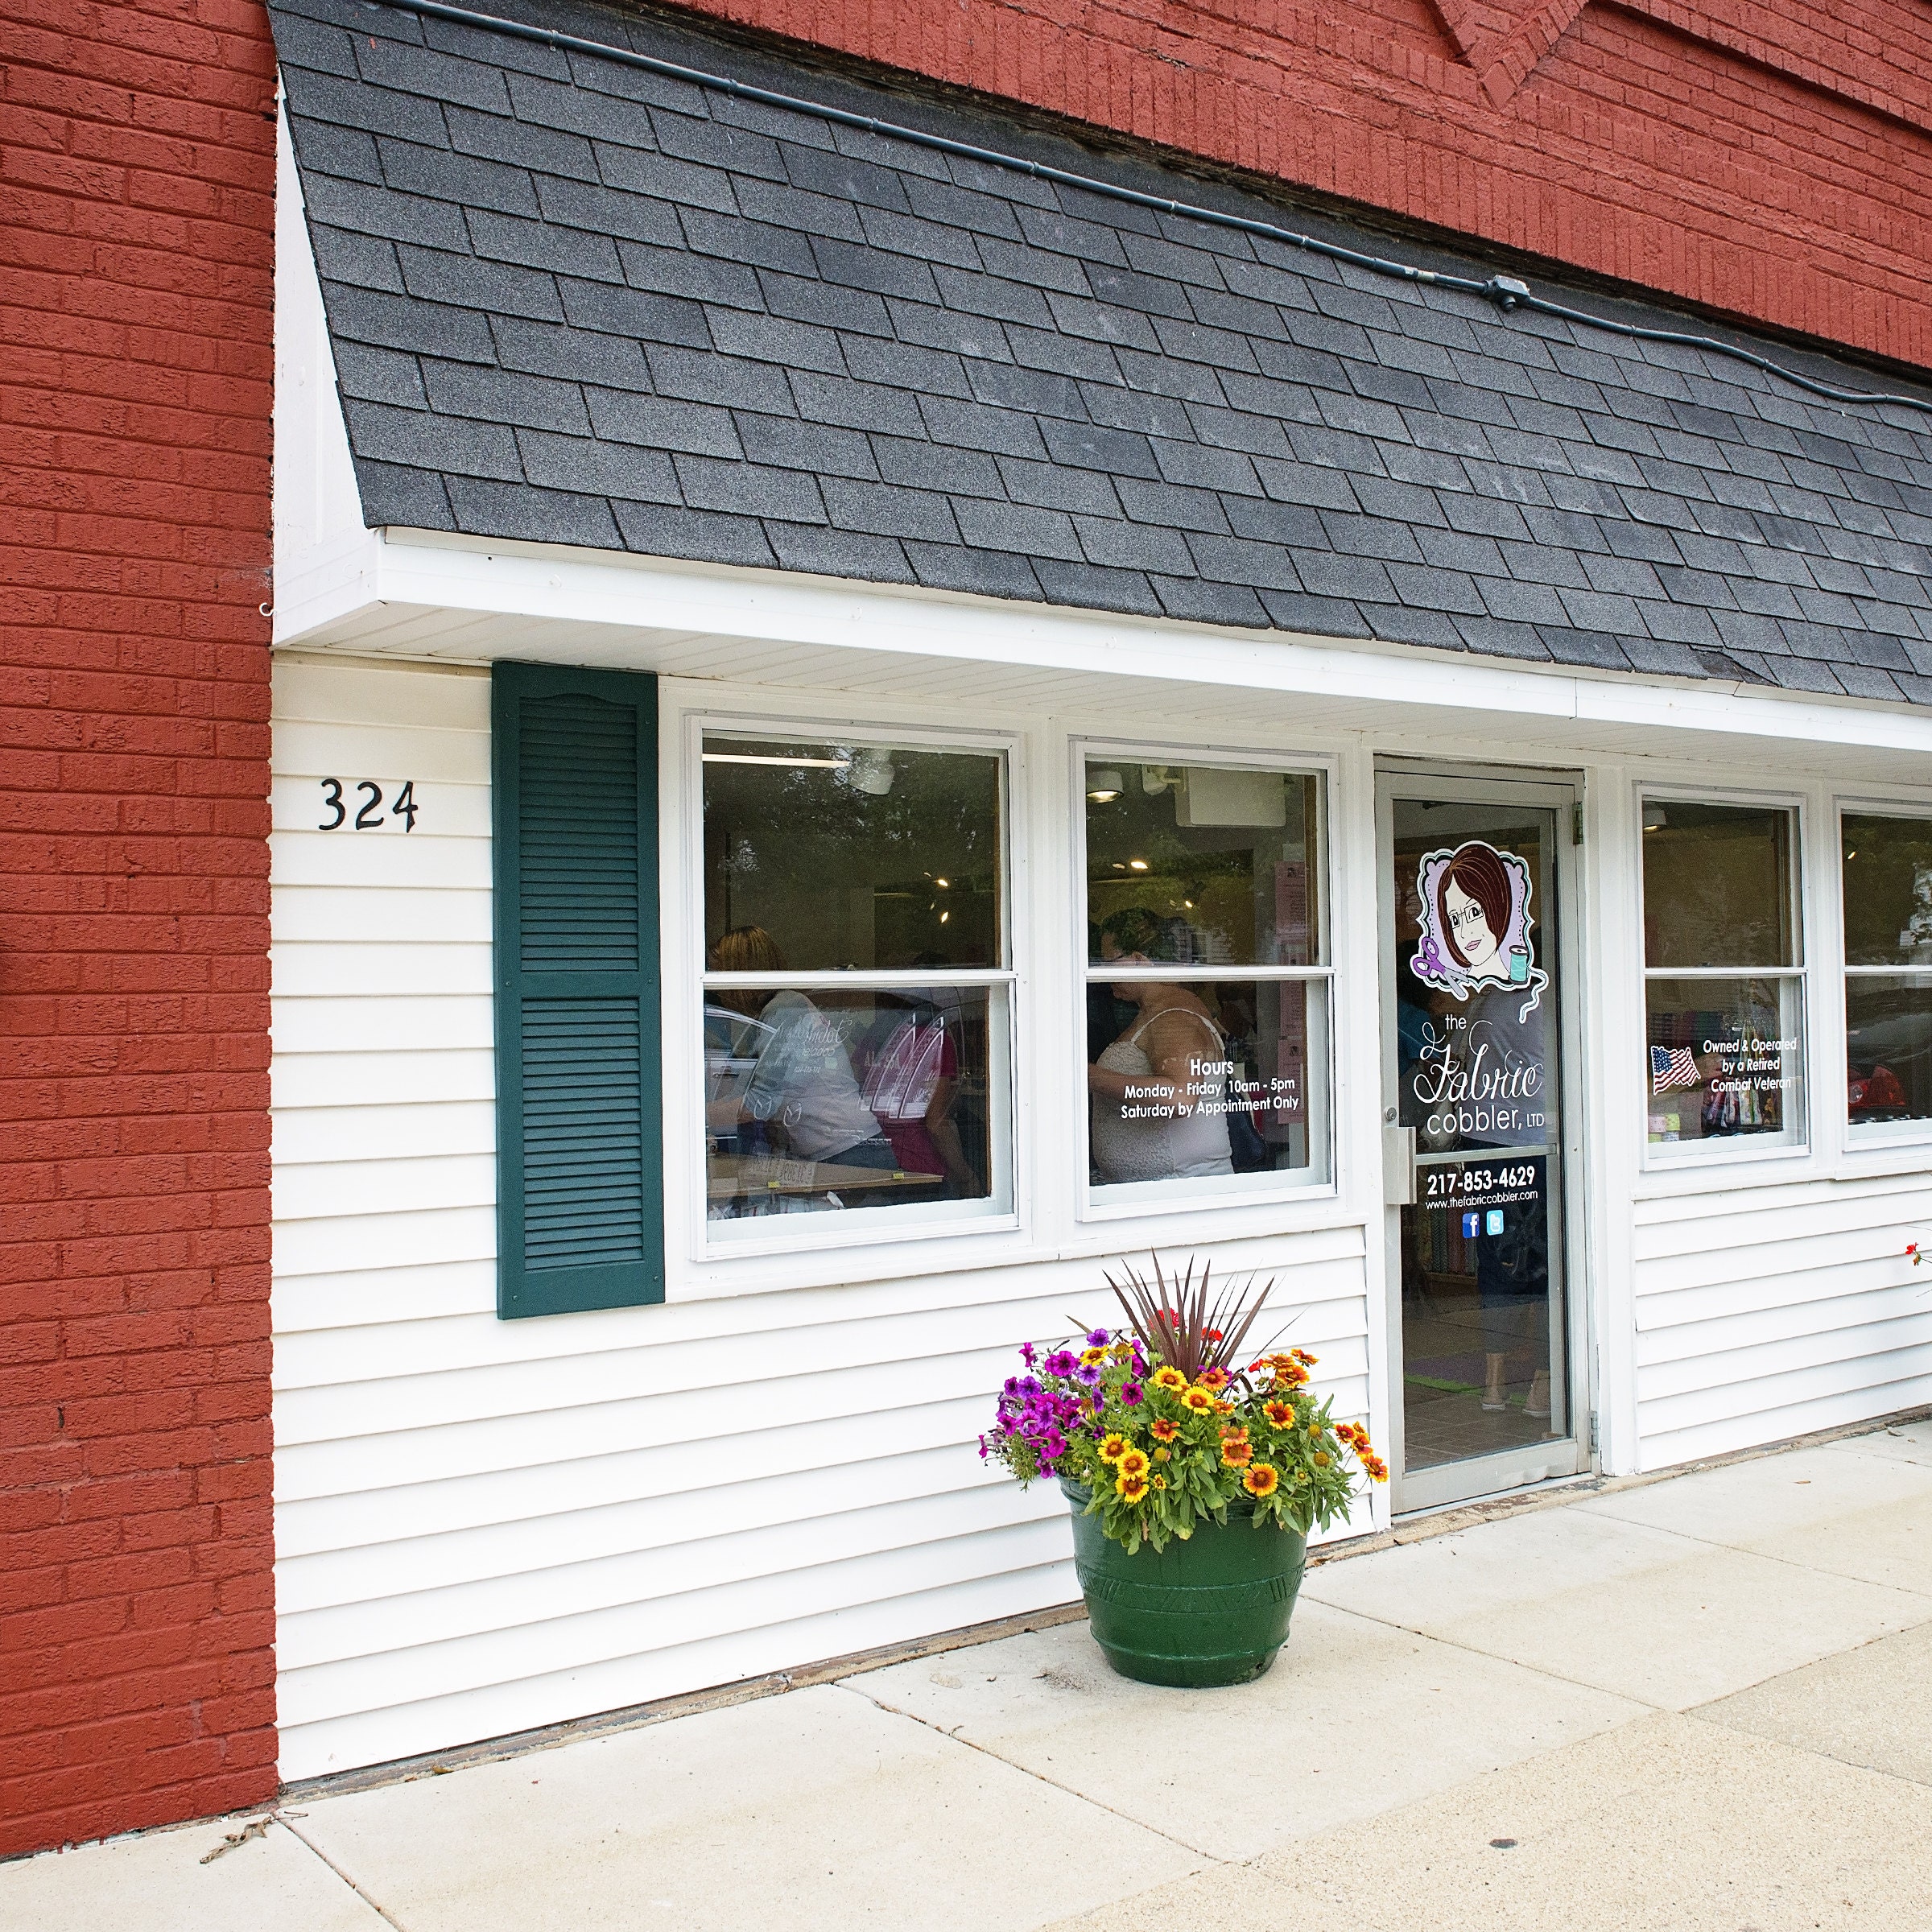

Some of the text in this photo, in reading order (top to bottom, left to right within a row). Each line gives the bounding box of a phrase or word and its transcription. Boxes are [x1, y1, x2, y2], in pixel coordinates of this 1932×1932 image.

[319, 778, 419, 834] 324
[1445, 1013, 1467, 1030] the
[1703, 1037, 1797, 1055] Owned & Operated
[1190, 1058, 1234, 1076] Hours
[1414, 1020, 1544, 1104] Fabric
[1721, 1056, 1781, 1075] by a Retired
[1124, 1084, 1175, 1100] Monday
[1187, 1081, 1222, 1097] Friday
[1228, 1080, 1260, 1093] 10am
[1270, 1077, 1295, 1093] 5pm
[1711, 1076, 1791, 1092] Combat Veteran
[1121, 1095, 1299, 1119] Saturday by Appointment Only
[1426, 1105, 1545, 1135] cobbler, LTD
[1426, 1165, 1536, 1196] 217-853-4629
[1425, 1189, 1538, 1211] www.thefabriccobbler.com
